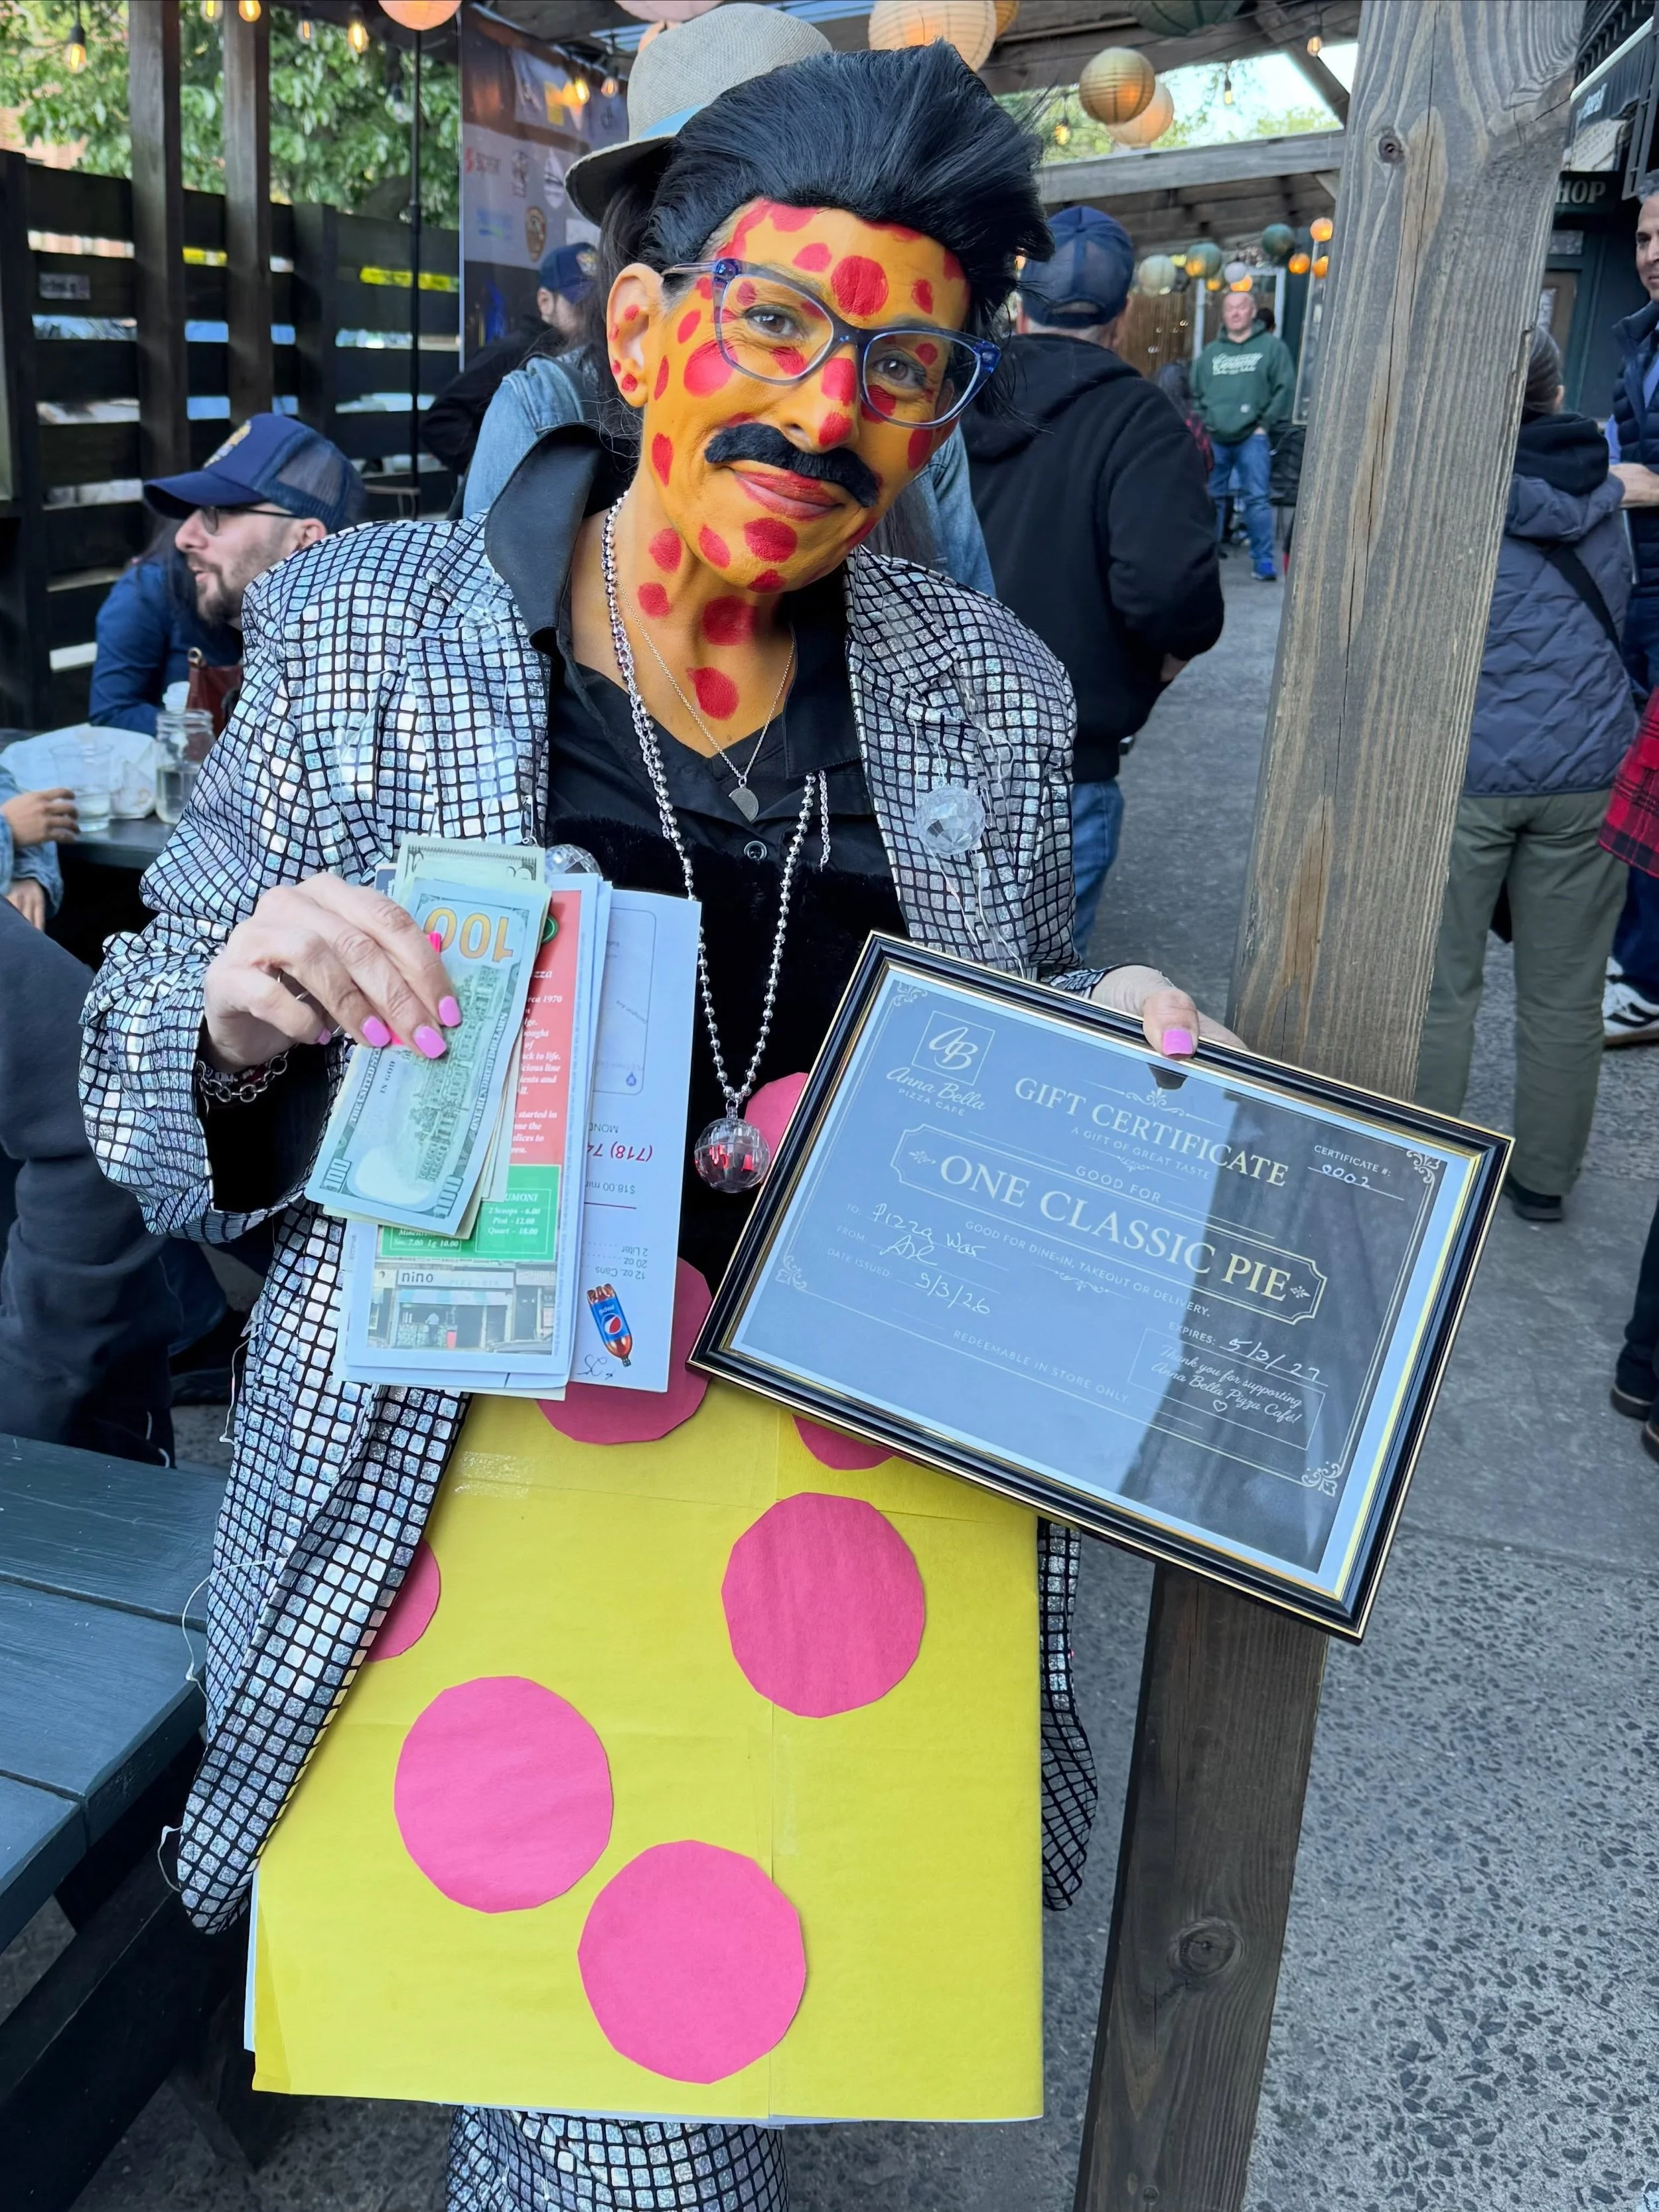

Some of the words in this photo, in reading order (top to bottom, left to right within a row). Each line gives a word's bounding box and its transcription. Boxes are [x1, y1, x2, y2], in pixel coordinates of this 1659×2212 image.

[1555, 180, 1607, 204] HOP
[423, 907, 514, 963] 100
[542, 995, 563, 1003] 1970
[380, 1082, 388, 1094] IN
[384, 1059, 396, 1081] GOD
[886, 1067, 935, 1092] Anna
[937, 1082, 985, 1110] Bella
[898, 1088, 930, 1104] PIZZA
[1015, 1077, 1086, 1115] GIFT
[1092, 1104, 1287, 1185] CERTIFICATE
[610, 1141, 653, 1163] (718)
[1083, 1130, 1110, 1144] GIFT
[1113, 1140, 1129, 1151] OF
[1132, 1147, 1171, 1165] GREAT
[1176, 1161, 1209, 1179] TASTE
[1314, 1144, 1378, 1172] CERTIFICATE
[323, 1156, 351, 1191] 100
[1076, 1165, 1123, 1189] GOOD
[1129, 1183, 1161, 1203] FOR
[1319, 1164, 1372, 1188] 0002
[603, 1181, 636, 1194] $18.00
[940, 1155, 1029, 1207] ONE
[1040, 1191, 1214, 1273] CLASSIC
[1222, 1253, 1290, 1301] PIE
[621, 1245, 641, 1255] Liter
[623, 1257, 634, 1266] oz
[642, 1248, 648, 1256] 2
[827, 1248, 852, 1262] DATE
[854, 1258, 892, 1277] ISSUED:
[965, 1220, 1000, 1238] GOOD
[1003, 1234, 1026, 1249] FOR
[1080, 1262, 1130, 1286] TAKEOUT
[1132, 1282, 1150, 1294] OR
[595, 1266, 618, 1278] Cans
[635, 1258, 648, 1269] 20
[636, 1270, 646, 1280] 12
[401, 1271, 434, 1283] nino
[1168, 1321, 1215, 1345] EXPIRES:
[953, 1330, 1029, 1365] REDEEMABLE
[1034, 1362, 1048, 1372] IN
[1051, 1366, 1091, 1388] STORE
[1161, 1345, 1199, 1367] Thank
[1196, 1364, 1220, 1382] you
[1222, 1369, 1242, 1385] for
[1242, 1380, 1303, 1409] supporting
[1151, 1362, 1186, 1382] Anna
[1189, 1374, 1223, 1396] Bella
[1226, 1388, 1261, 1410] Pizza
[1263, 1404, 1302, 1424] Café!
